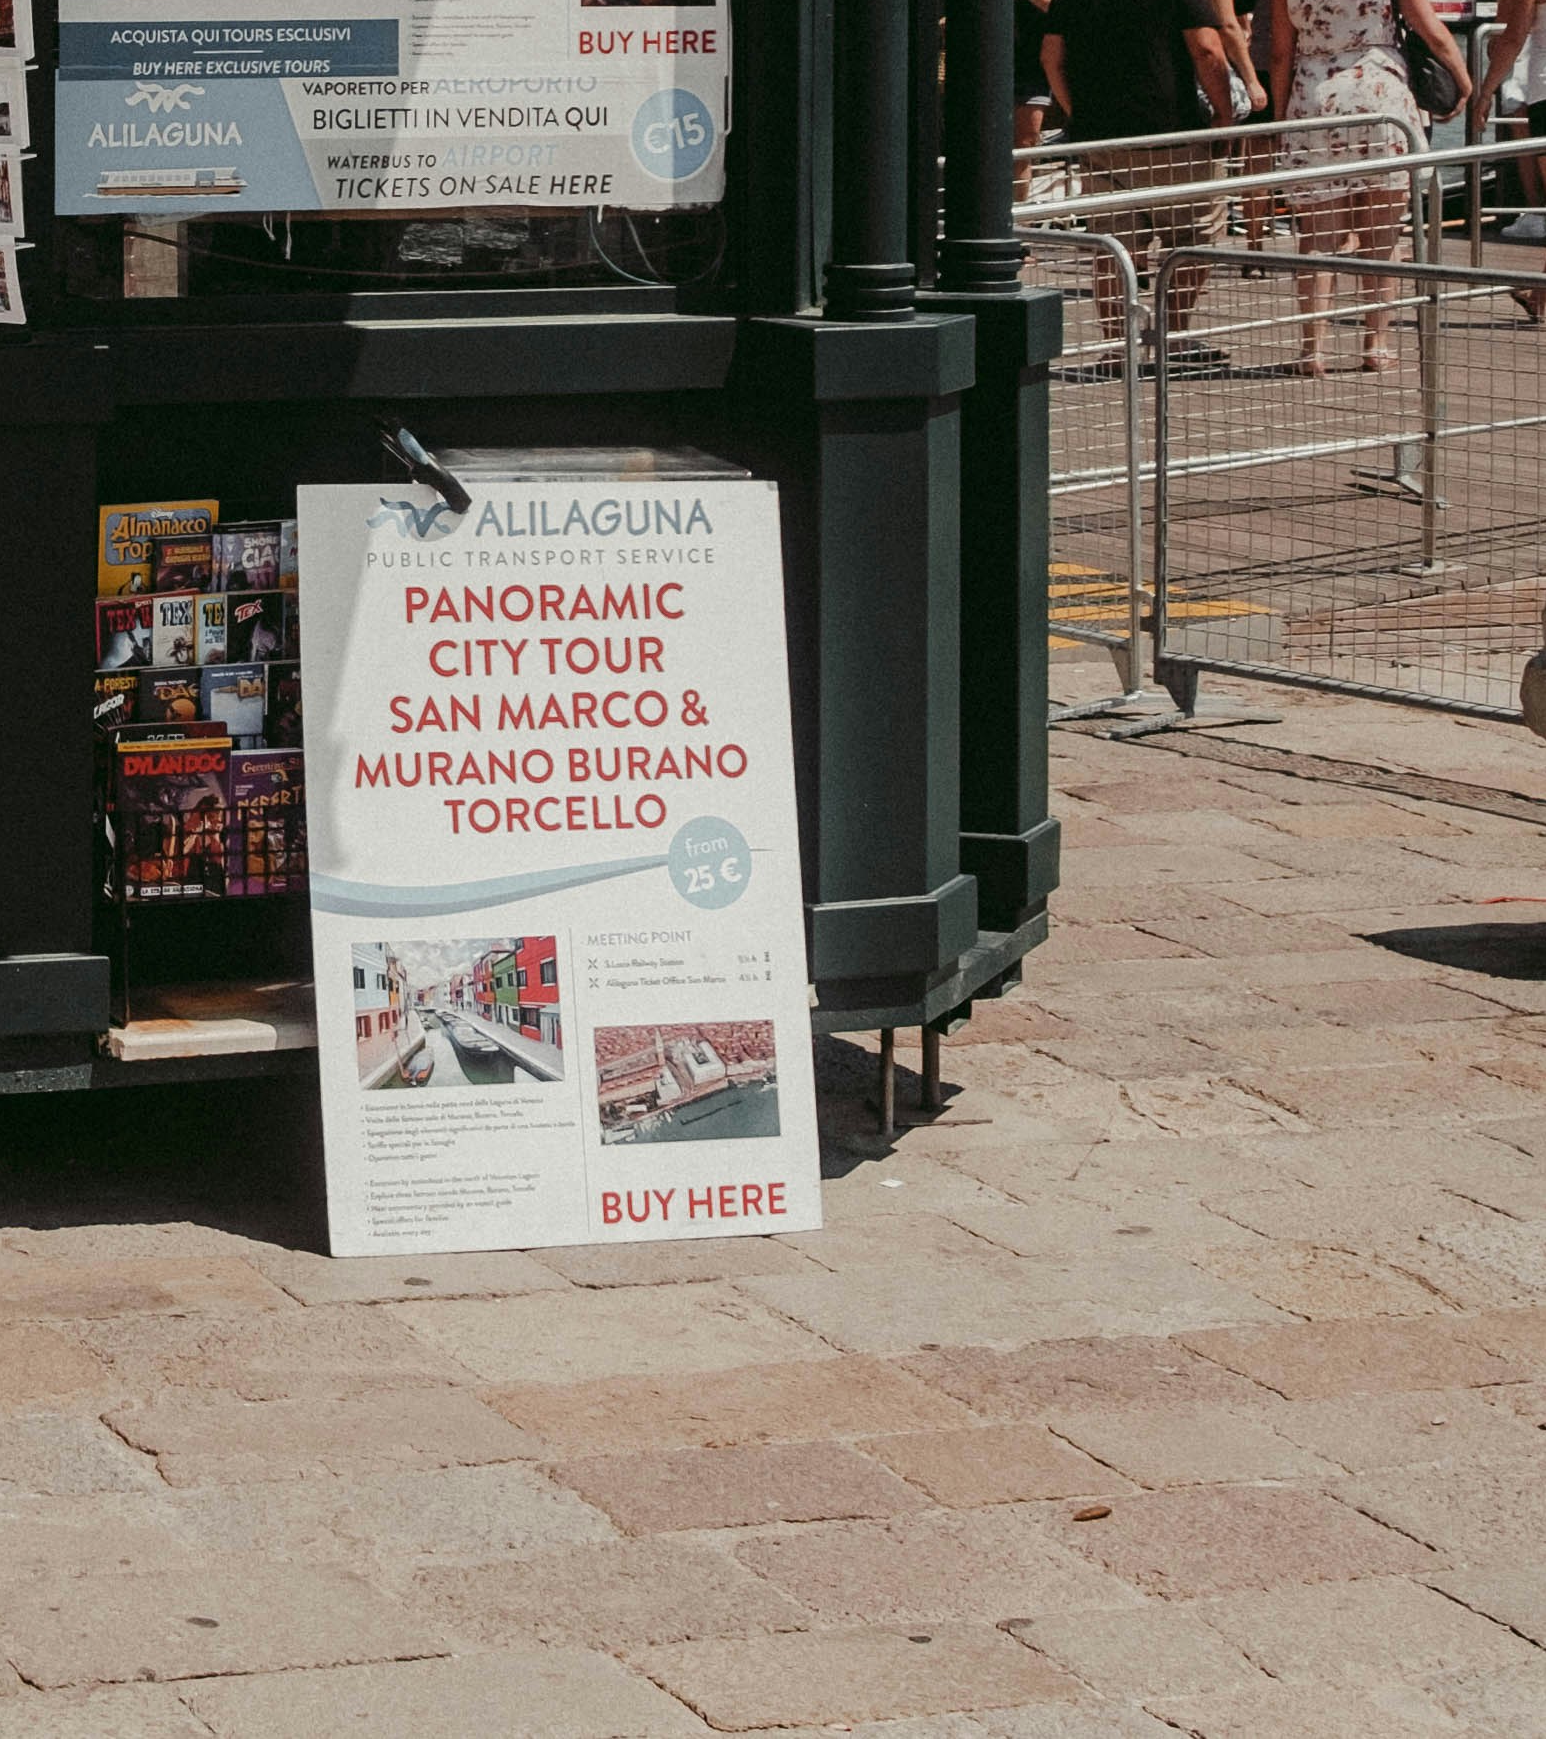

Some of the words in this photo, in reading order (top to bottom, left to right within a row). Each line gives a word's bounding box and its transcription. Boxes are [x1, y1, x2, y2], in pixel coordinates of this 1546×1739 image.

[110, 29, 188, 47] ACQUISTA
[192, 29, 220, 46] QUI
[224, 28, 274, 44] TOURS
[277, 27, 352, 43] ESCLUSIVI
[579, 30, 635, 55] BUY
[642, 29, 717, 55] HERE
[132, 61, 162, 76] BUY
[166, 60, 202, 75] HERE
[205, 60, 280, 75] EXCLUSIVE
[283, 59, 330, 74] TOURS
[302, 82, 397, 96] VAPORETTO
[400, 81, 429, 96] PER
[312, 108, 417, 130] BIGLIETTI
[426, 108, 449, 129] IN
[457, 107, 559, 129] VENDITA
[565, 107, 608, 129] QUI
[87, 121, 242, 148] ALILAGUNA
[642, 112, 707, 154] €15
[327, 154, 412, 170] WATERBUS
[417, 154, 437, 168] TO
[442, 144, 558, 168] AIRPORT
[335, 177, 431, 199] TICKETS
[439, 176, 476, 197] ON
[485, 175, 539, 195] SALE
[550, 174, 613, 195] HERE
[111, 516, 207, 540] Almanacco
[475, 498, 715, 538] ALILAGUNA
[366, 550, 453, 569] PUBLIC
[464, 549, 607, 567] TRANSPORT
[617, 547, 715, 565] SERVICE
[160, 601, 193, 626] TEX
[234, 599, 264, 624] TEX
[404, 581, 686, 625] PANORAMIC
[107, 609, 136, 632] TEX
[428, 638, 530, 678] CITY
[538, 636, 665, 675] TOUR
[390, 694, 483, 734] SAN
[497, 690, 669, 732] MARCO
[682, 689, 710, 726] &
[123, 755, 182, 776] DYLAN
[184, 753, 226, 774] DOG
[355, 748, 555, 790] MURANO
[568, 743, 749, 783] BURANO
[444, 793, 667, 835] TORCELLO
[684, 833, 730, 857] from
[683, 864, 717, 896] 25
[721, 858, 743, 887] €
[587, 932, 647, 946] MEETING
[652, 930, 692, 944] POINT
[601, 1188, 675, 1225] BUY
[687, 1182, 788, 1221] HERE
